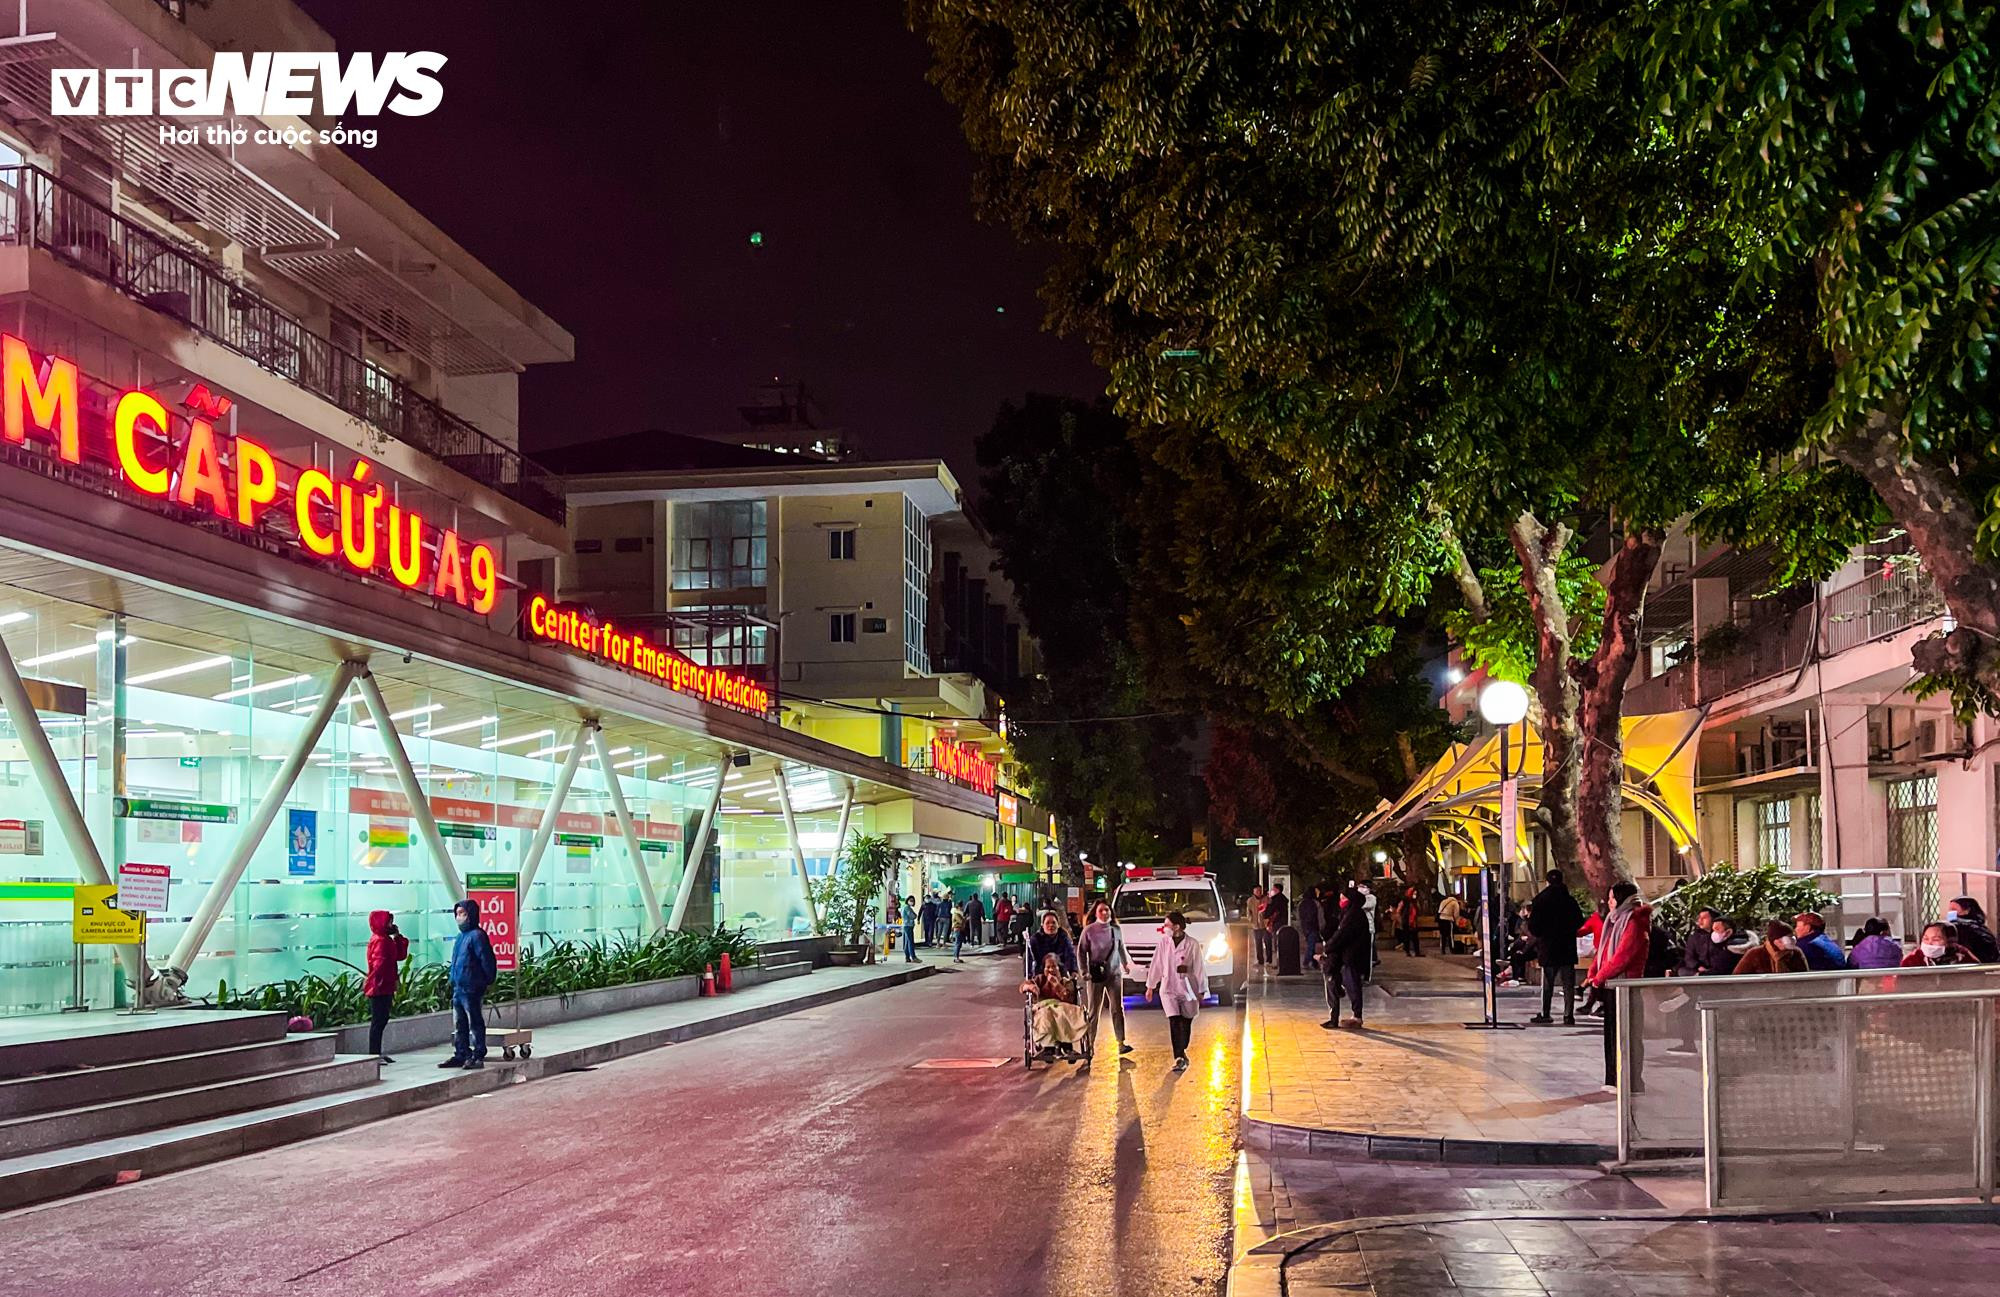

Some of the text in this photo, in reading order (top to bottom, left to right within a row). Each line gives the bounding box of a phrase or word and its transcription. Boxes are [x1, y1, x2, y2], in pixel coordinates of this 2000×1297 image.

[1, 332, 497, 614] M CẤP CỨU A9
[530, 594, 768, 713] Center for Emergency Medicine
[480, 895, 505, 914] LỐI
[493, 940, 515, 955] CỨU
